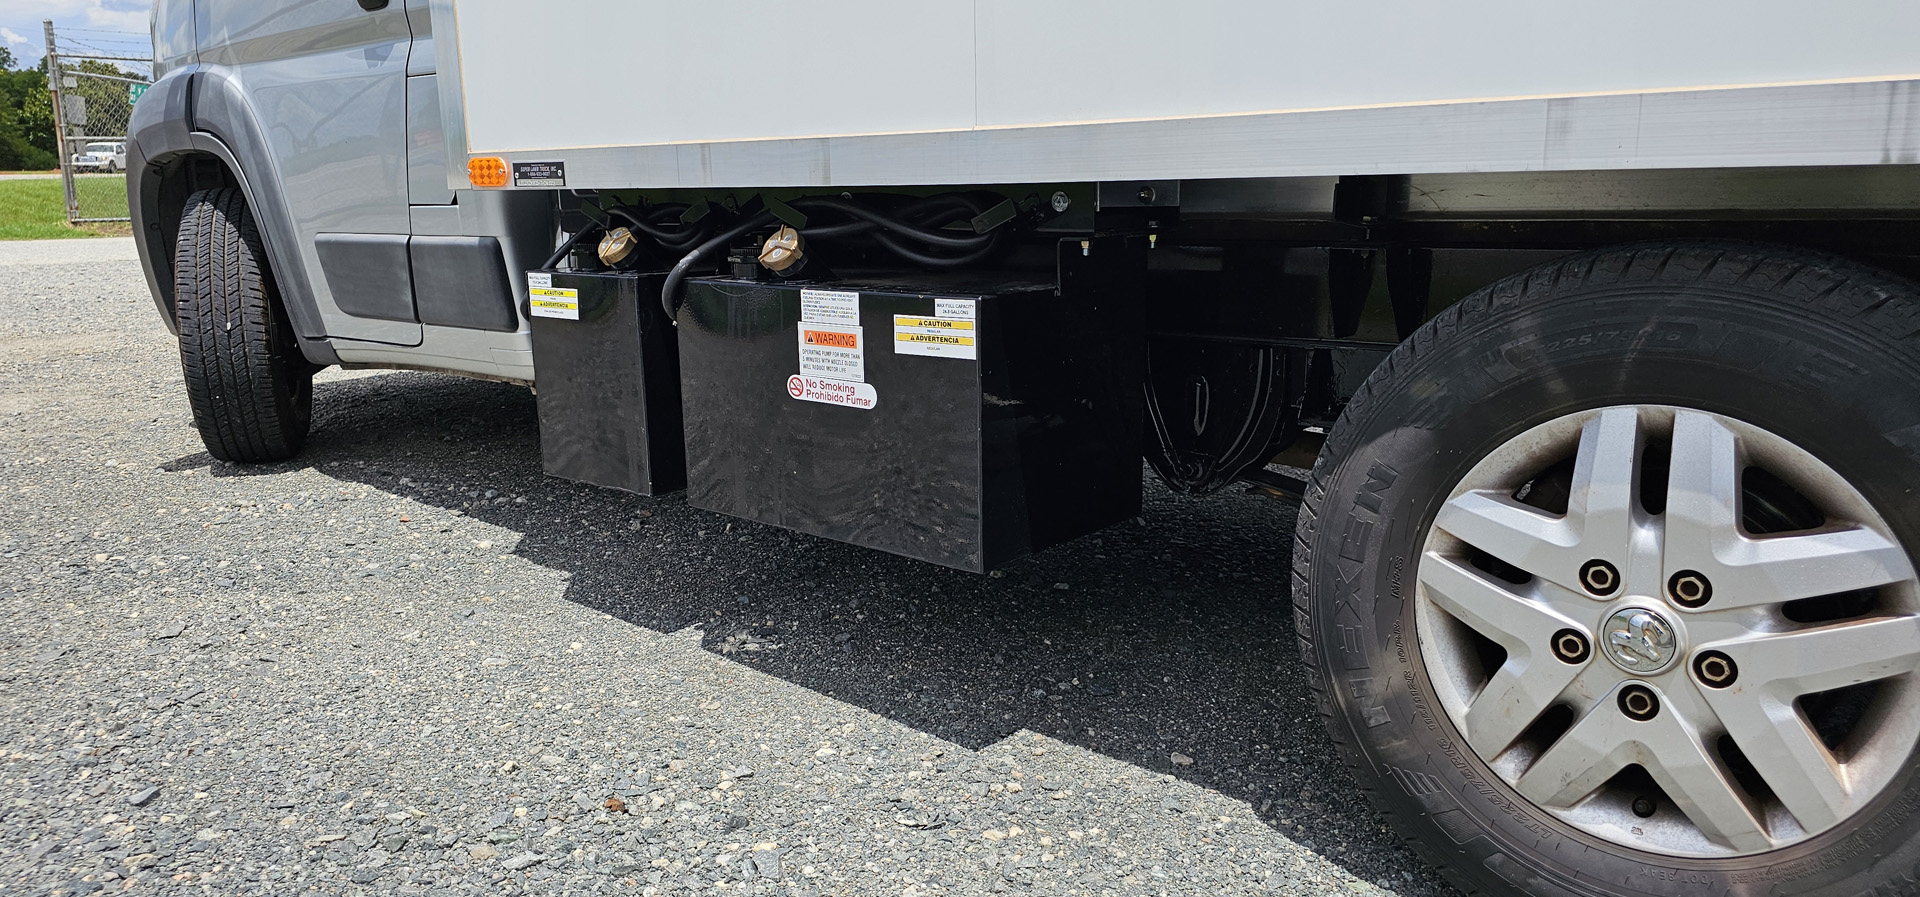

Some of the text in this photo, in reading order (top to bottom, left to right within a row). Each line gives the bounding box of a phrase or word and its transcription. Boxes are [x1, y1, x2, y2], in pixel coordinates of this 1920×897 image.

[816, 332, 855, 346] WARNING
[916, 335, 959, 343] ADVERTENCIA
[806, 379, 855, 396] No Smoking
[807, 390, 871, 407] Prohibido Fumar
[1336, 457, 1399, 729] NEXEN
